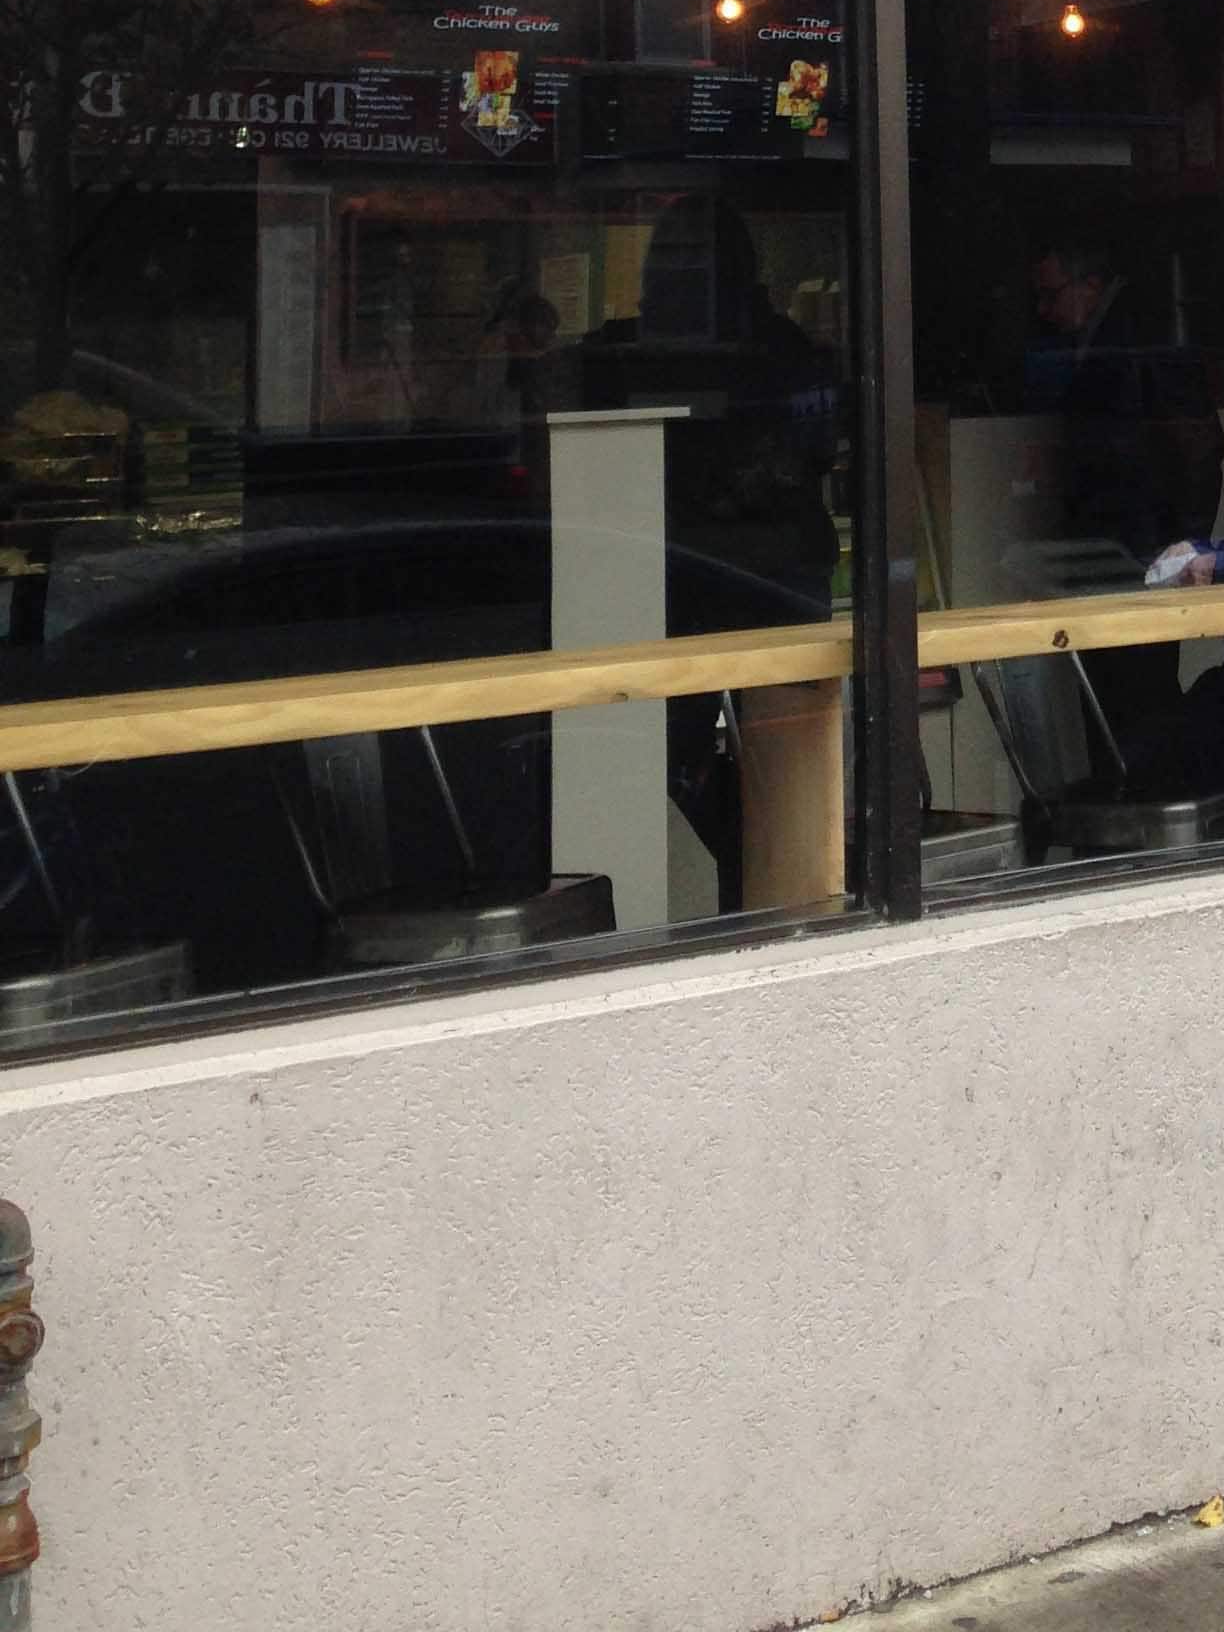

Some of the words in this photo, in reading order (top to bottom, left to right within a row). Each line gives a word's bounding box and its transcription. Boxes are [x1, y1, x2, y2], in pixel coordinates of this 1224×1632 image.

[478, 5, 518, 16] The
[433, 16, 510, 29] Chicken
[515, 20, 560, 32] Guys
